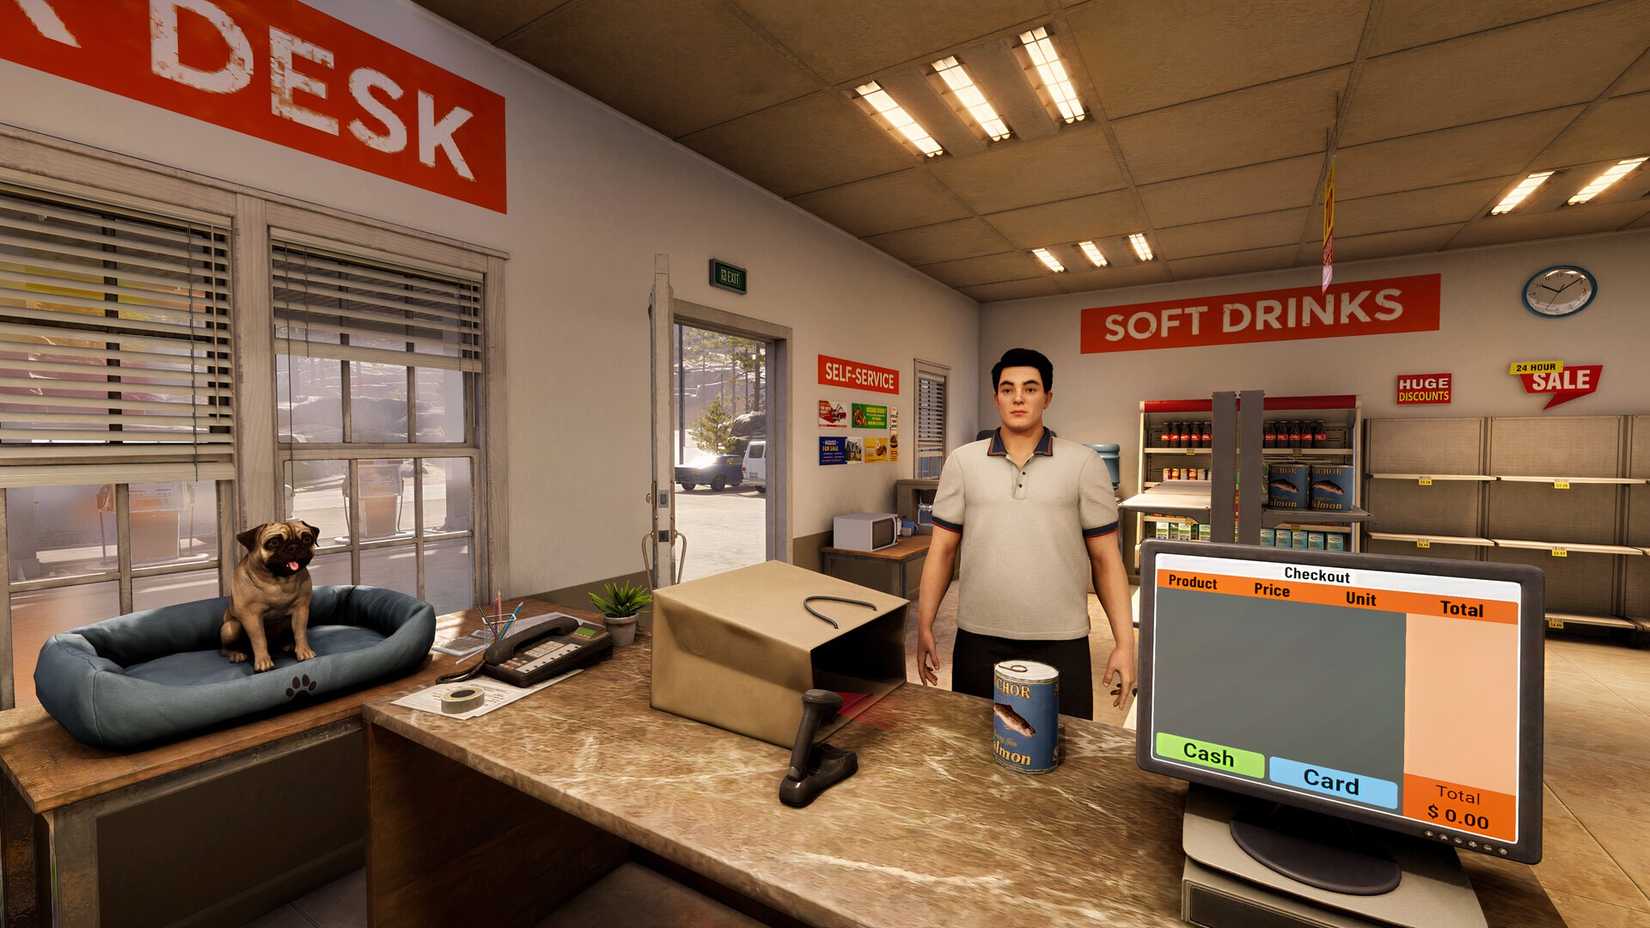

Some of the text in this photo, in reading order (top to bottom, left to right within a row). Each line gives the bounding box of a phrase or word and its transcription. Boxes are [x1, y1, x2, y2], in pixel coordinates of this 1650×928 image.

[150, 0, 476, 182] DESK
[727, 270, 740, 286] EXIT
[1105, 288, 1404, 342] SOFT DRINKS
[825, 362, 894, 389] SELF-SERVICE
[1516, 363, 1556, 372] 24 HOUR
[1400, 377, 1449, 390] HUGE
[1532, 370, 1590, 391] SALE
[1399, 390, 1449, 401] DISCOUNTS
[1284, 566, 1350, 584] Checkout
[1168, 574, 1484, 618] Product Price Unit Total
[1183, 741, 1235, 768] Cash
[1303, 768, 1360, 796] Card
[1436, 784, 1481, 806] Total
[1445, 808, 1490, 831] 0.00
